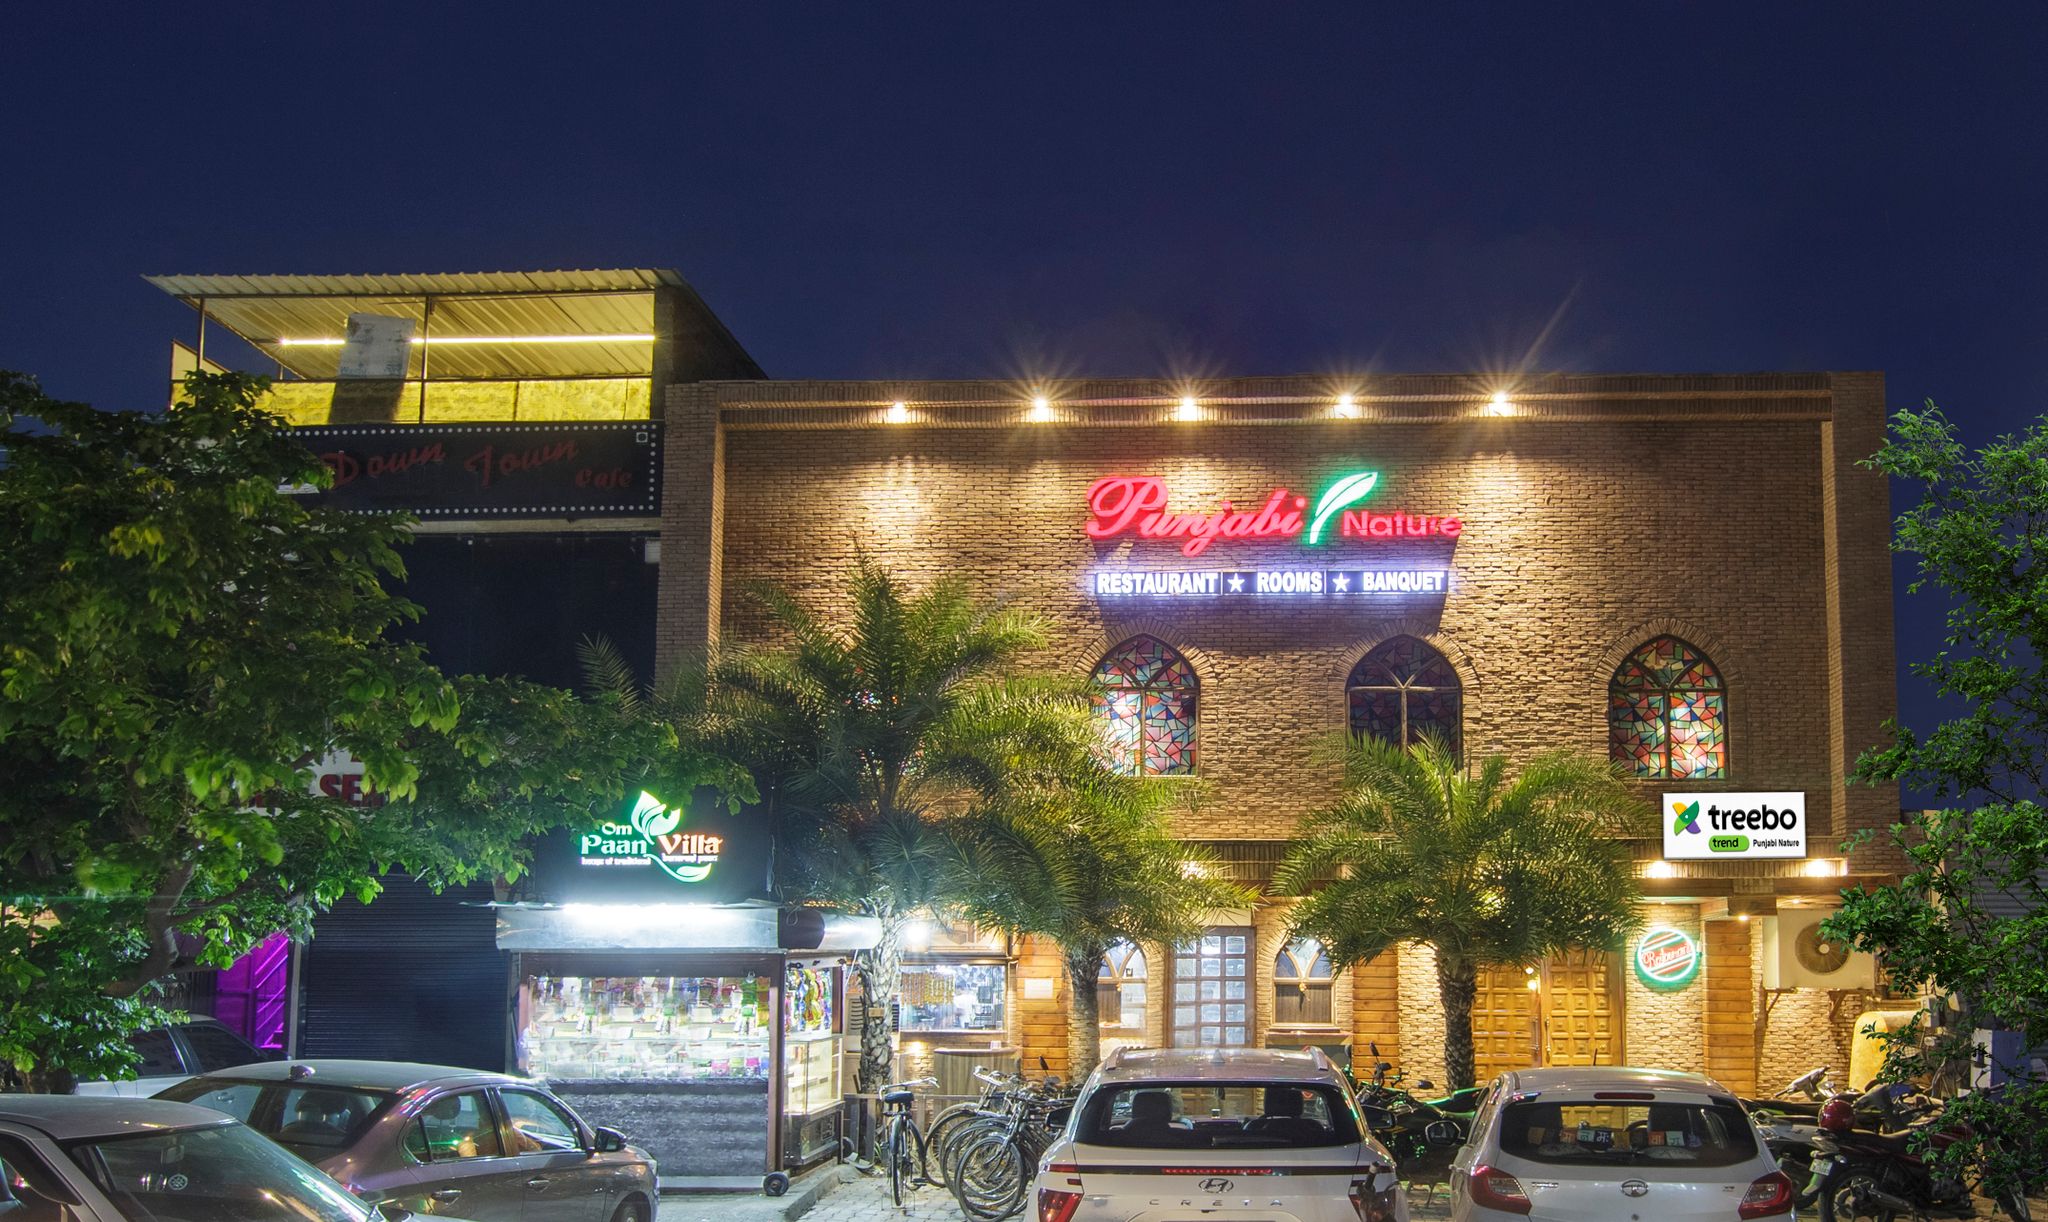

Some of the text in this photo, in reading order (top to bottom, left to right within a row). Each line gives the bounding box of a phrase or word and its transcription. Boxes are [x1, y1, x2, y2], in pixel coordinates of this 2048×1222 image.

[319, 438, 580, 490] Down Town
[574, 467, 632, 488] Cafe
[1086, 475, 1462, 557] Punjabi Nature
[1097, 570, 1443, 594] RESTAURANT ROOMS BANQUET
[1708, 804, 1797, 830] treebo
[601, 822, 633, 836] Om
[581, 834, 724, 855] Paan Villa
[1712, 838, 1800, 849] trend Punjabi Nature
[1149, 1199, 1283, 1207] CRETA
